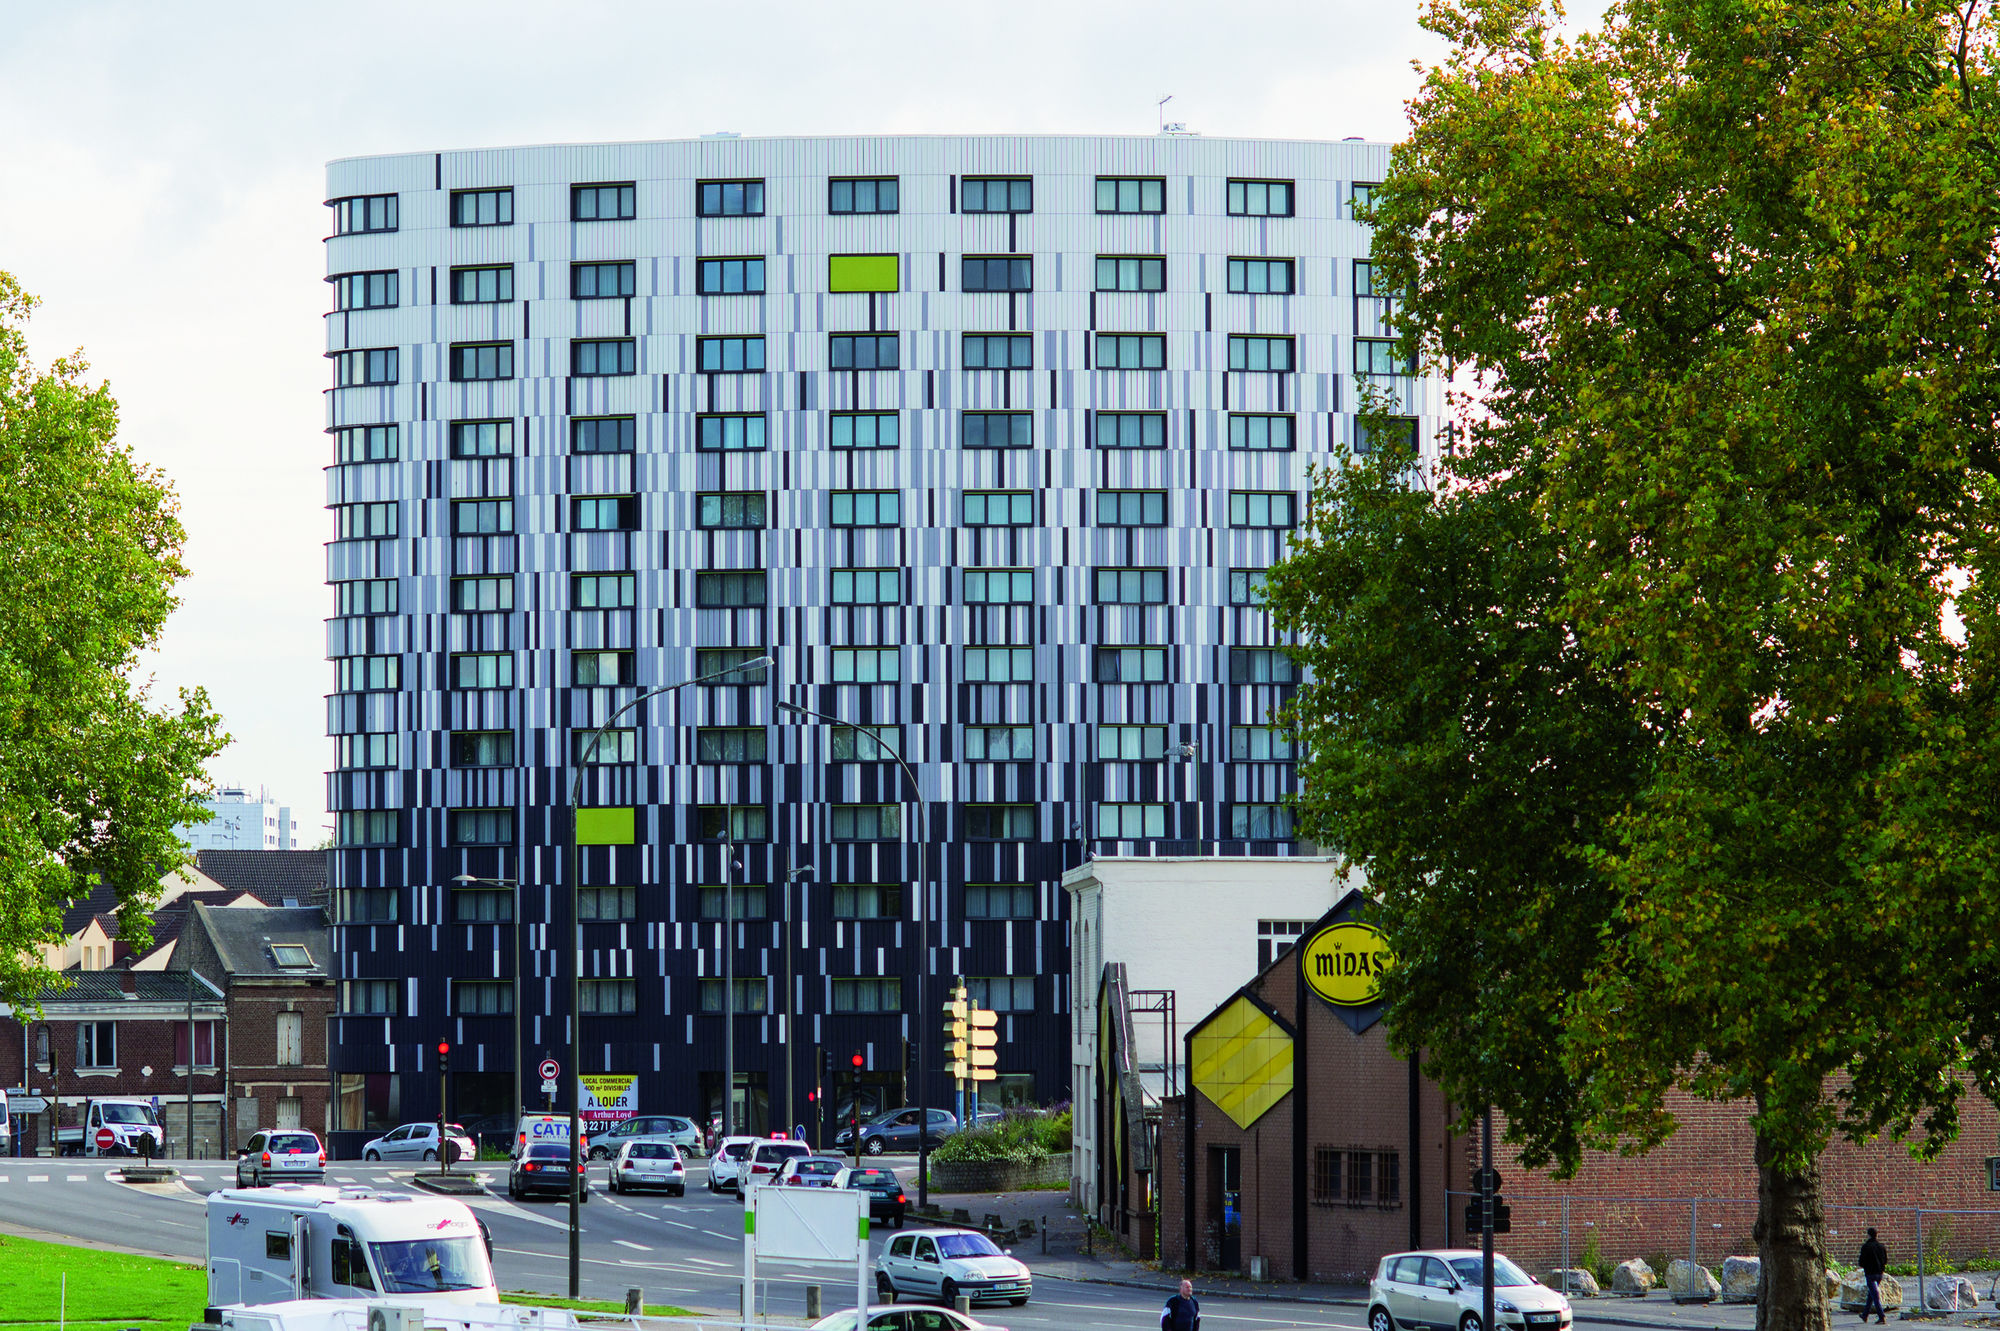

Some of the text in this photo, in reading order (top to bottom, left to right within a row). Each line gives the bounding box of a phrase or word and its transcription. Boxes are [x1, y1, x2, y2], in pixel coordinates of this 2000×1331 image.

[587, 1096, 628, 1107] A LOUER
[593, 1111, 632, 1119] Arthur Loyd
[533, 1123, 570, 1136] CATY
[589, 1121, 598, 1131] 22
[600, 1121, 608, 1131] 71
